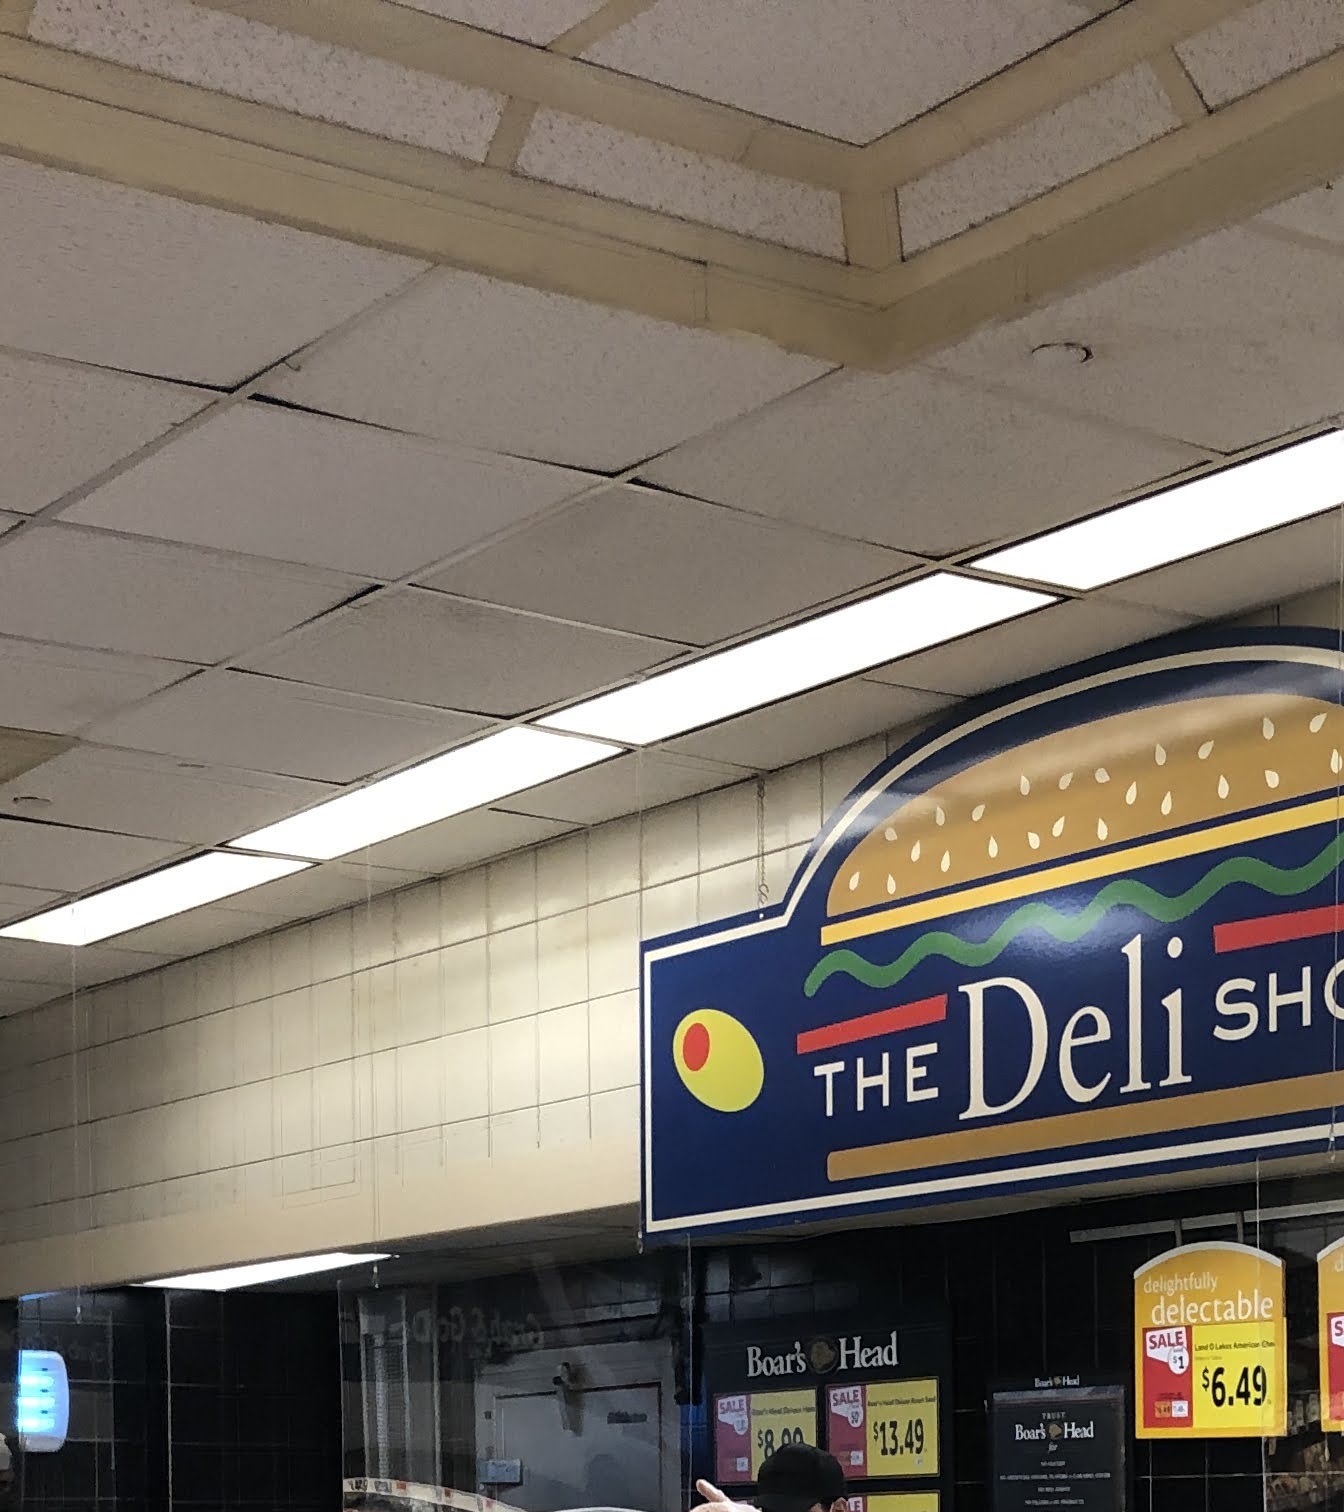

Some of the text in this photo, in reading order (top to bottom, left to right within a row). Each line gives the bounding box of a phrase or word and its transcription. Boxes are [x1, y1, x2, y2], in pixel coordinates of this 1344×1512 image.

[813, 1042, 940, 1118] THE
[957, 932, 1193, 1122] Deli
[1143, 1271, 1219, 1297] delightfully
[1151, 1290, 1274, 1326] delectable
[1148, 1331, 1185, 1350] SALE
[747, 1330, 899, 1378] Boar's Head
[1173, 1355, 1185, 1369] $1
[832, 1389, 860, 1407] SALE
[1202, 1364, 1267, 1407] $6.49
[719, 1398, 746, 1415] SALE
[873, 1418, 925, 1456] $13.49
[1014, 1420, 1095, 1441] Boar's Head
